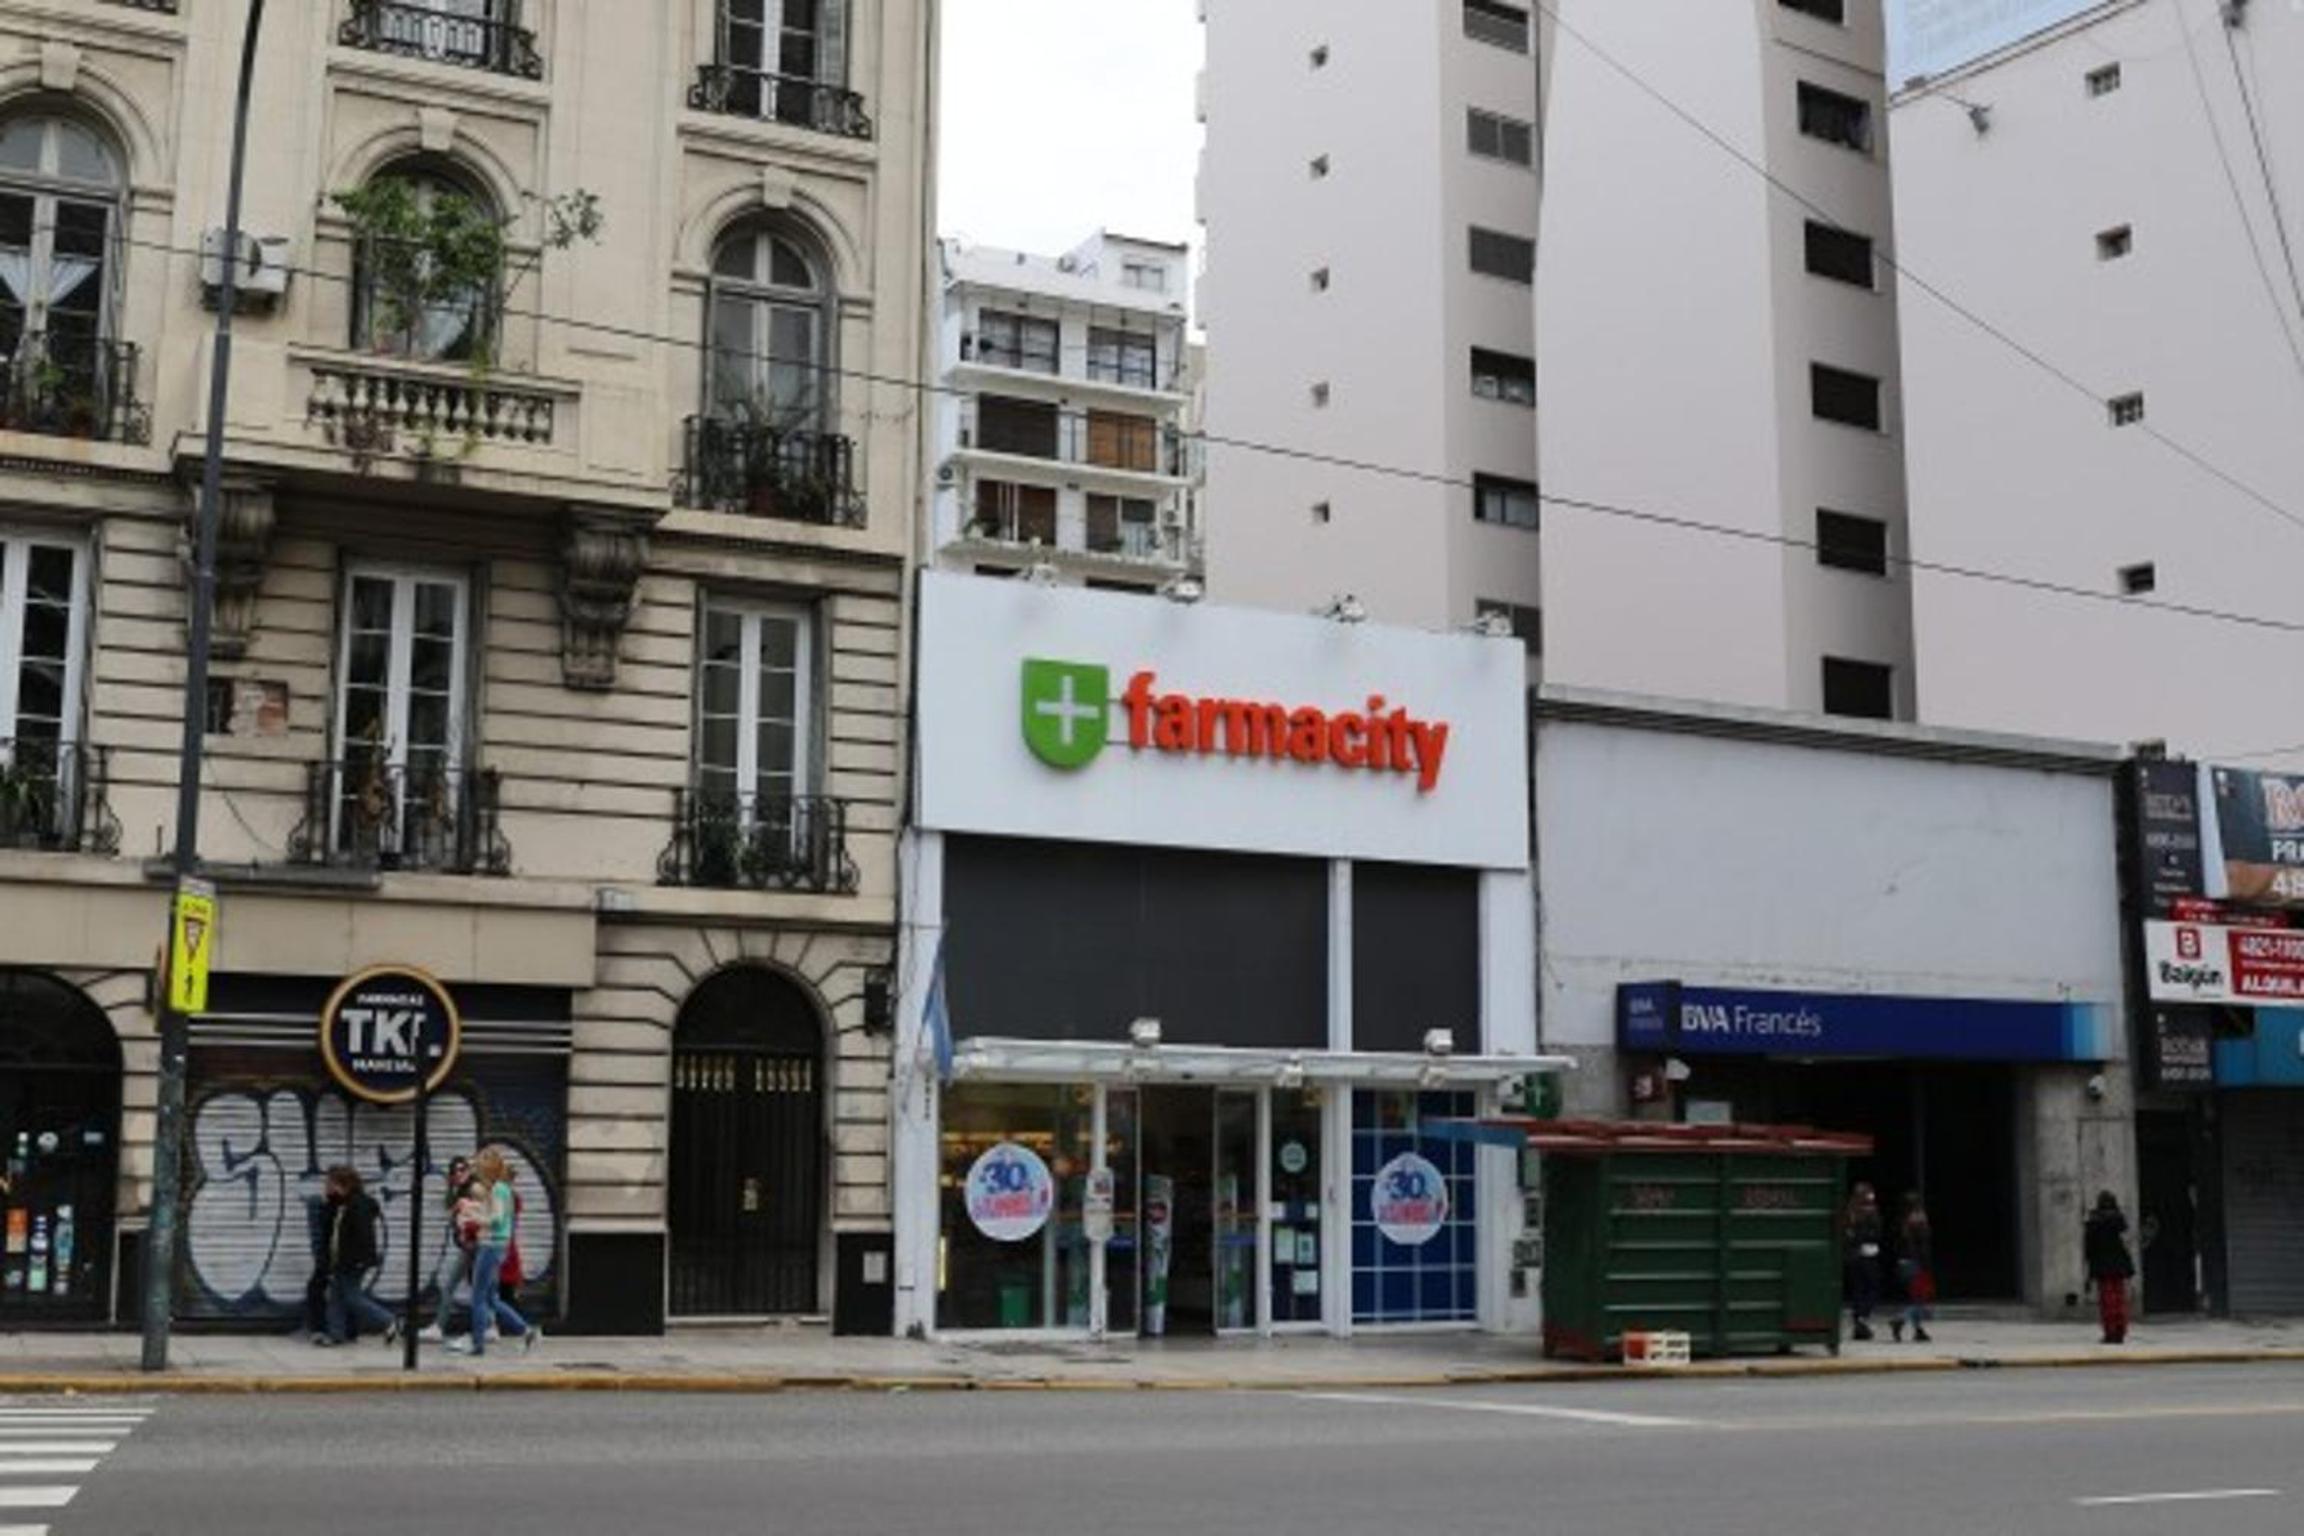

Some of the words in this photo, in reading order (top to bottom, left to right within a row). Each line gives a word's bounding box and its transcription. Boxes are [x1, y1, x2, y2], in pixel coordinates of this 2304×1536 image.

[1122, 670, 1449, 792] farmacity
[2272, 839, 2304, 863] PR
[1733, 1005, 1822, 1038] Francés
